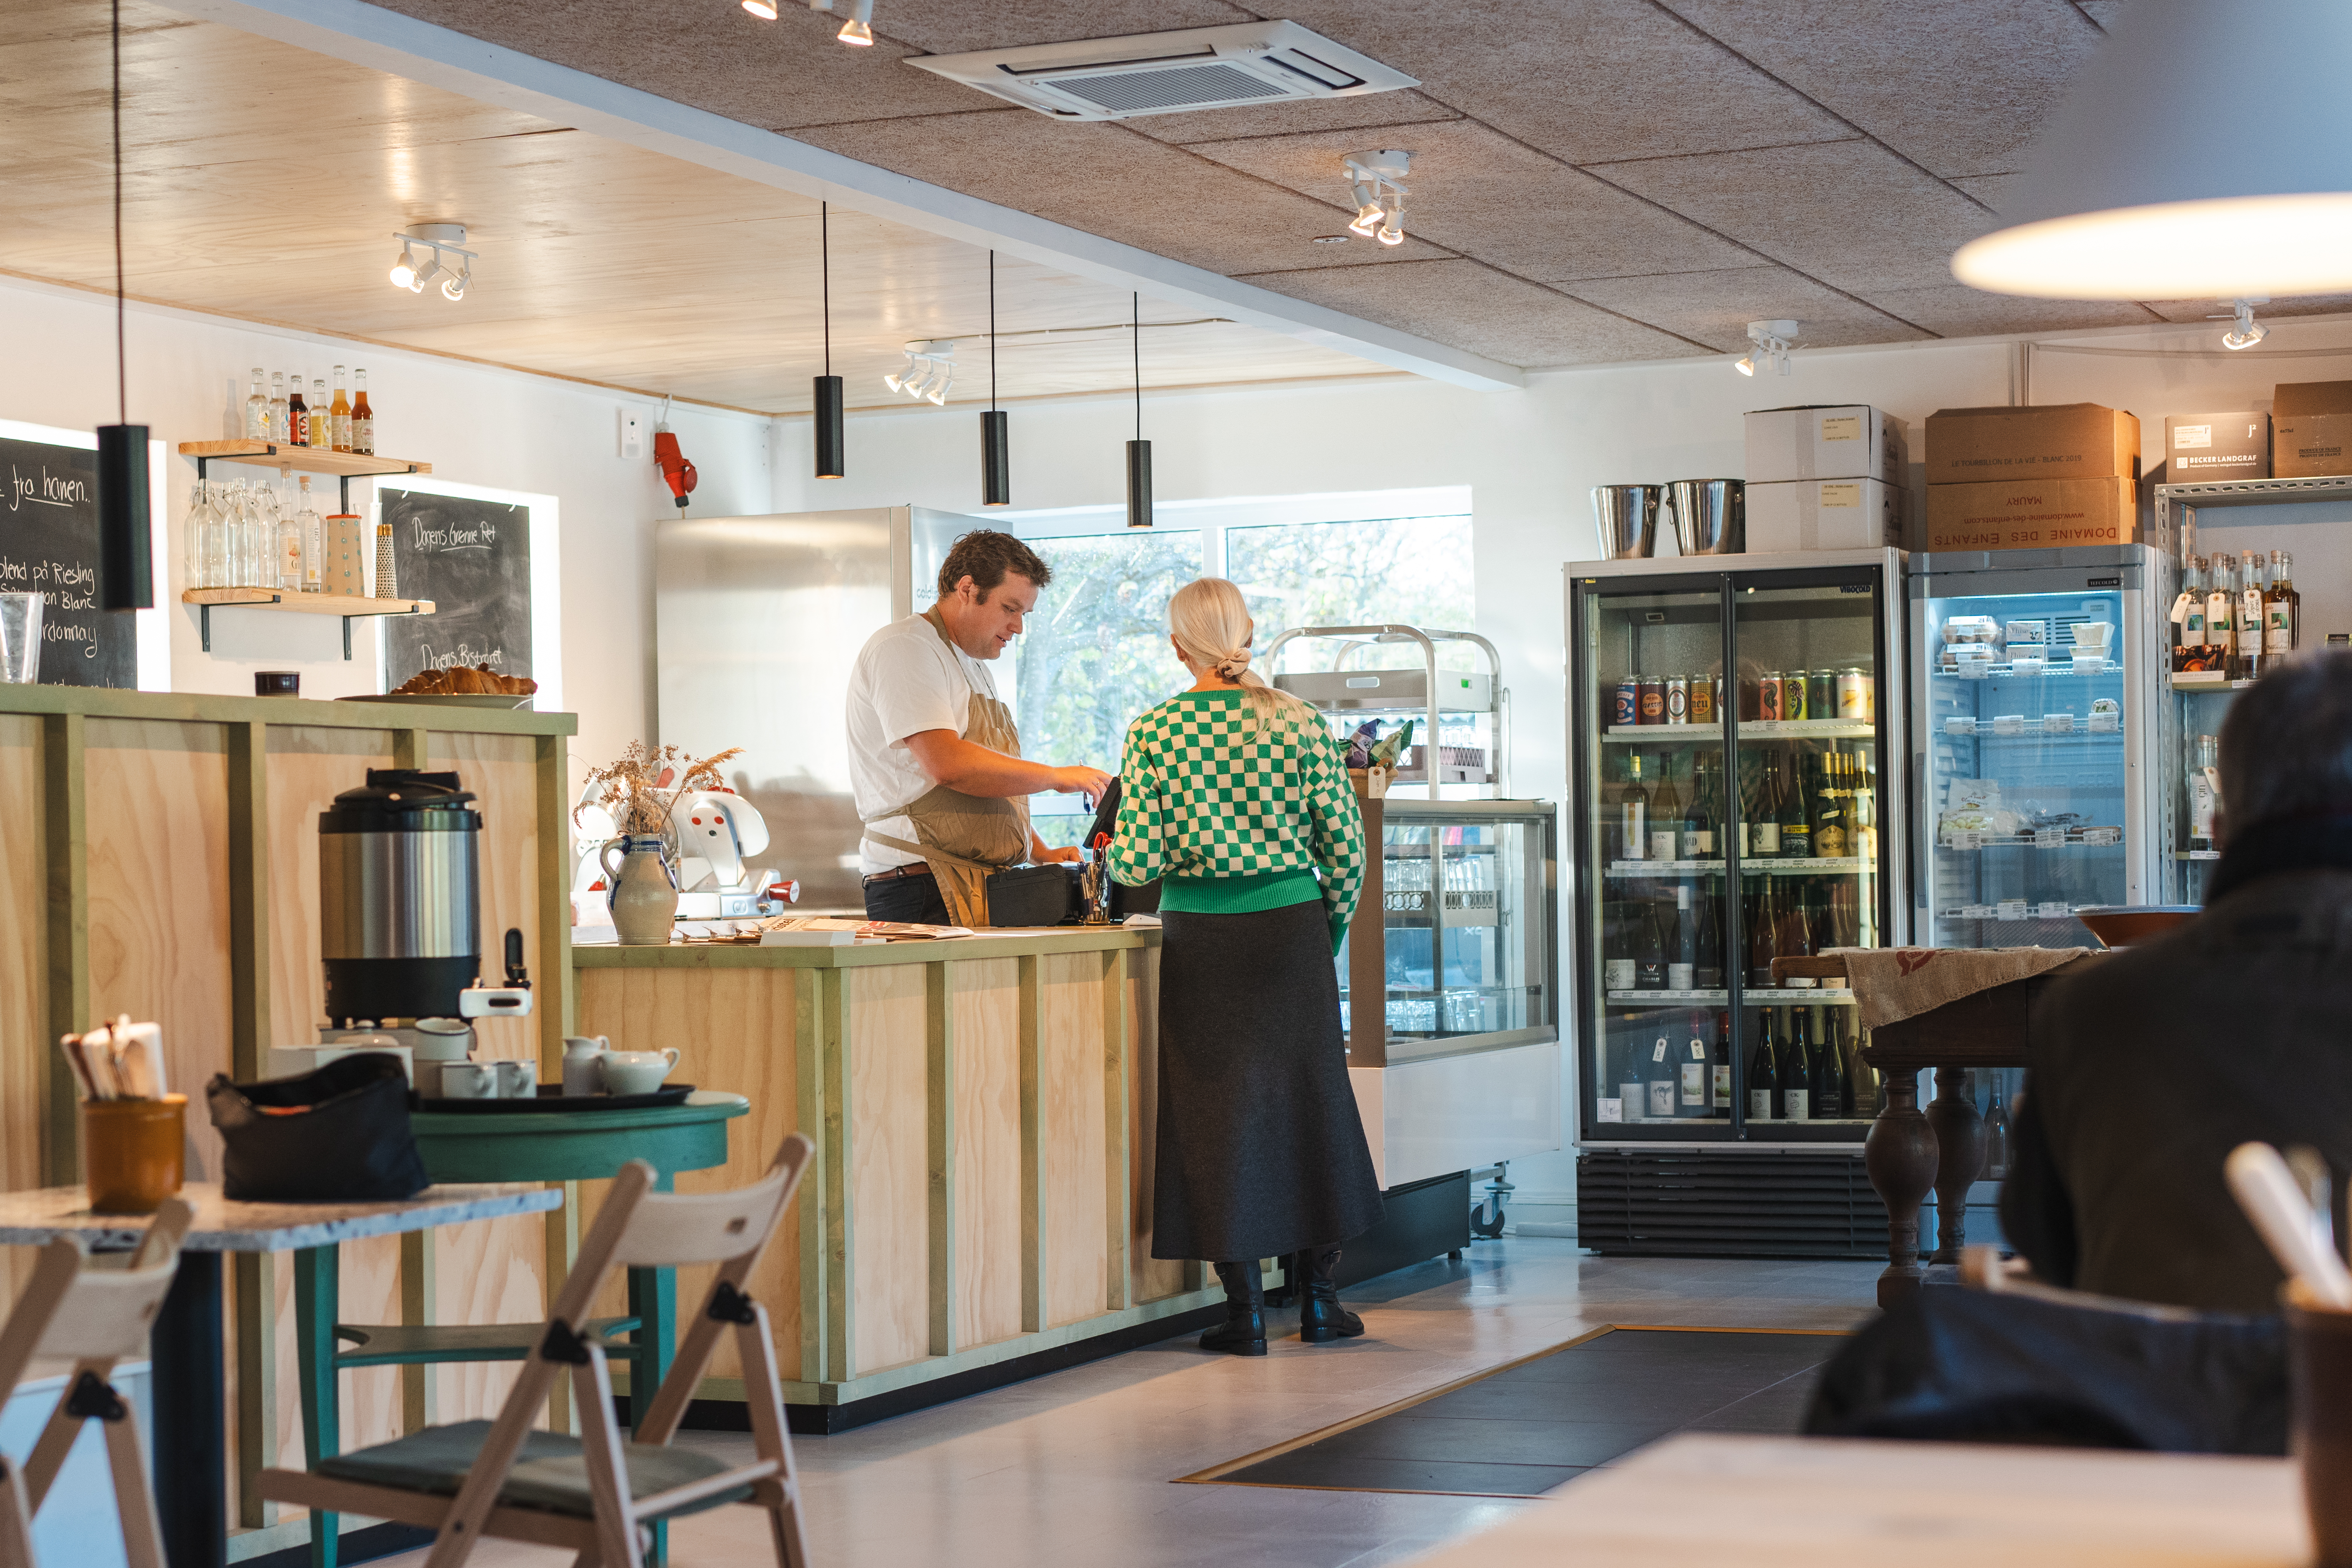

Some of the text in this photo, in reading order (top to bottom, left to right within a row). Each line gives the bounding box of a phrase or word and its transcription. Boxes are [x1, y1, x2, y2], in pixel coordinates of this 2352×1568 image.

[10, 464, 34, 511] fra
[2007, 496, 2042, 506] MAURY
[1964, 512, 2084, 524] www.domaine-des-enfants.com
[412, 517, 447, 552] Dagens
[480, 521, 495, 543] Ret
[1934, 527, 2116, 546] DOMAINE DES ENFANTS
[33, 560, 48, 593] på
[52, 561, 95, 595] Riesling
[62, 591, 96, 611] Blanc
[42, 620, 97, 659] rdonnay
